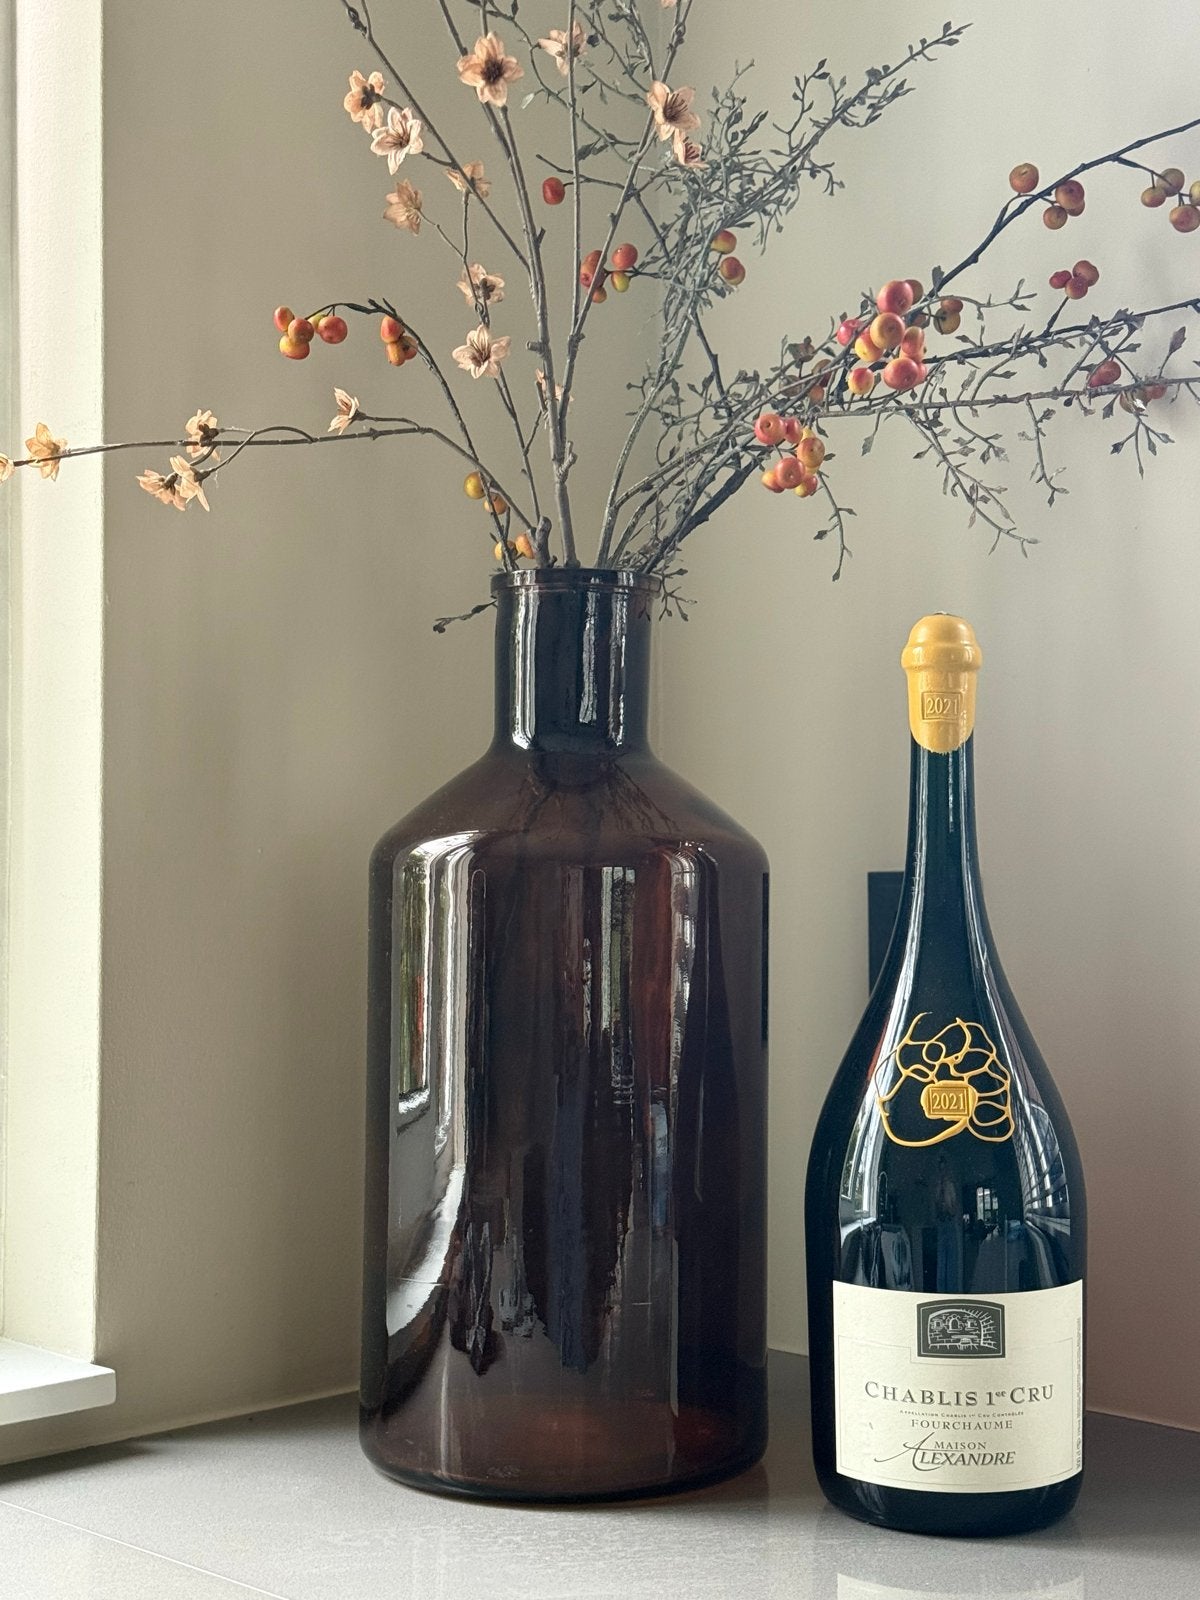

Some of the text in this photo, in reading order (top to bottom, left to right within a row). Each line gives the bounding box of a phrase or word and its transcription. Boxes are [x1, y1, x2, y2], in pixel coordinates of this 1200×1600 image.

[926, 697, 959, 715] 2021
[932, 1092, 965, 1110] 2021
[1010, 1383, 1053, 1404] CRU
[911, 1418, 1014, 1431] FOURCHAUME
[934, 1441, 987, 1450] MAISON
